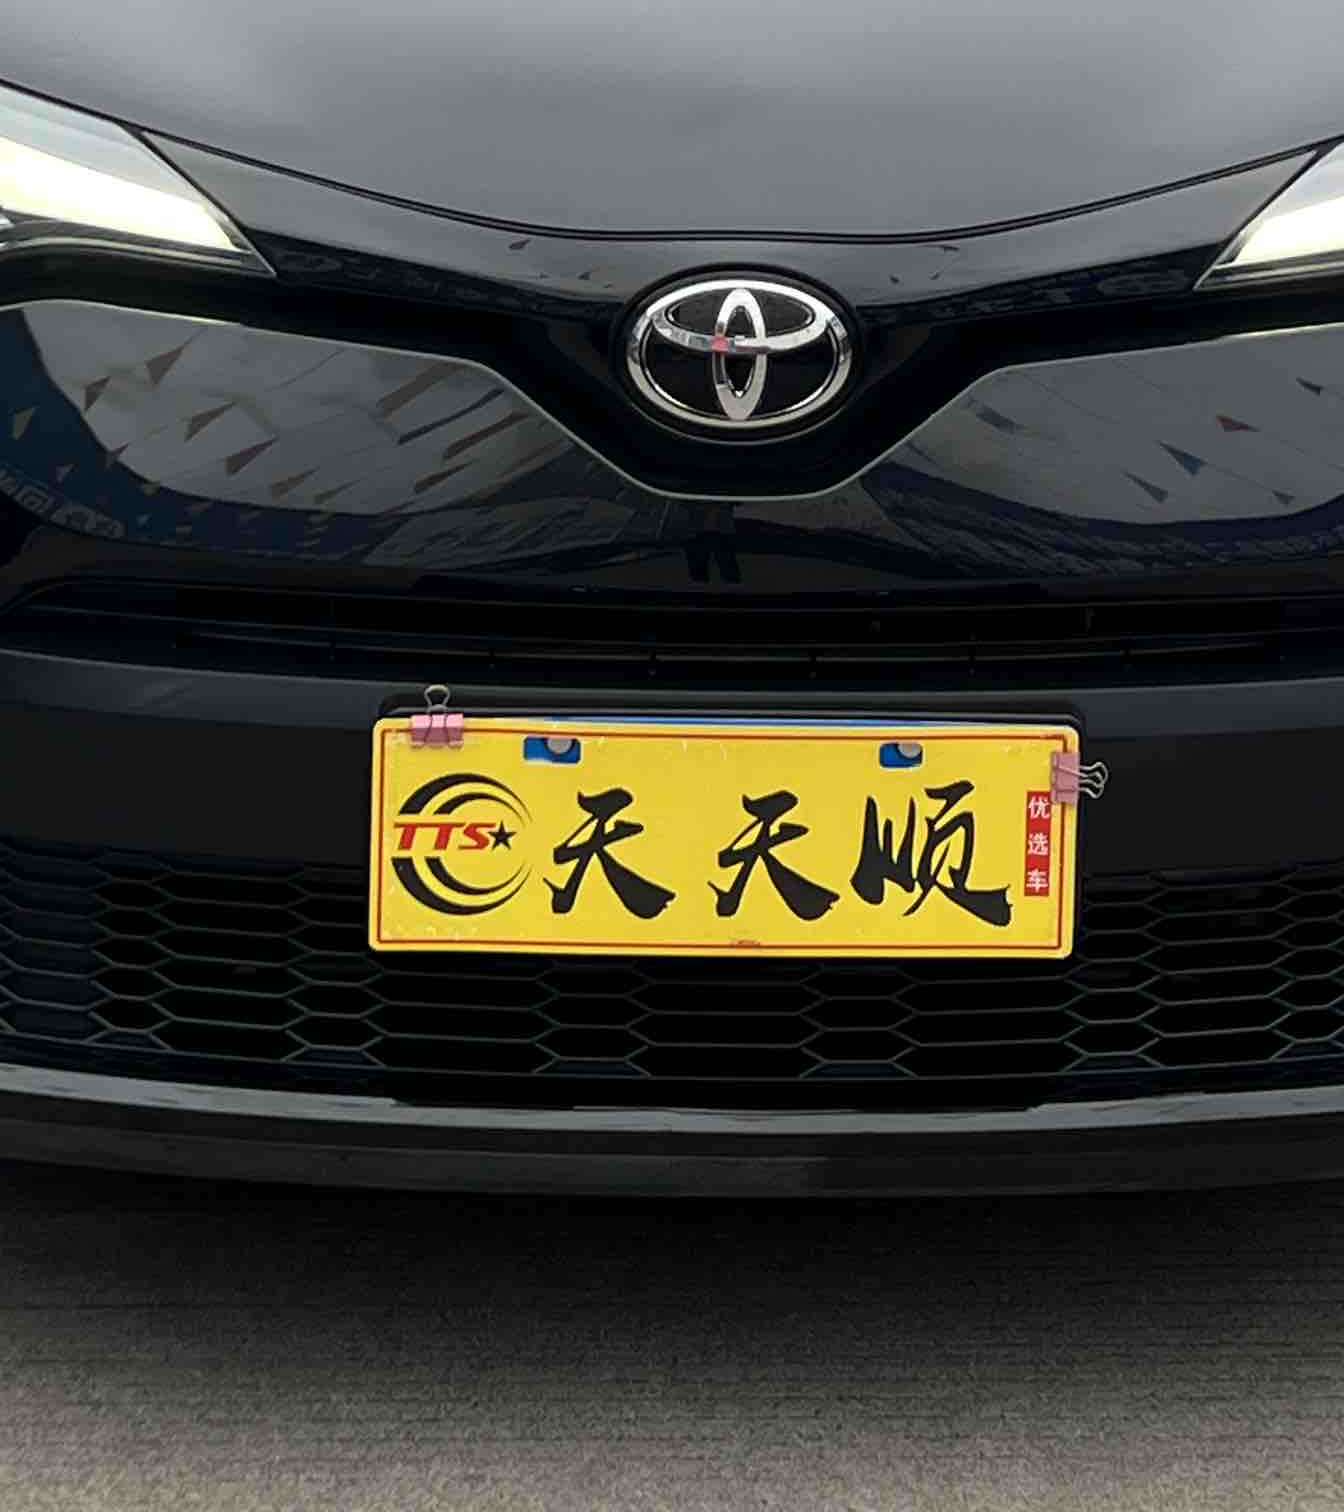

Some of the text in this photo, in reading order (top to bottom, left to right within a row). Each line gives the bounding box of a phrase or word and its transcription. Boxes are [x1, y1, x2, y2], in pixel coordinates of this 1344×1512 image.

[393, 821, 497, 851] TTS
[542, 779, 1012, 927] 天天顺
[1026, 795, 1051, 894] 优选车
